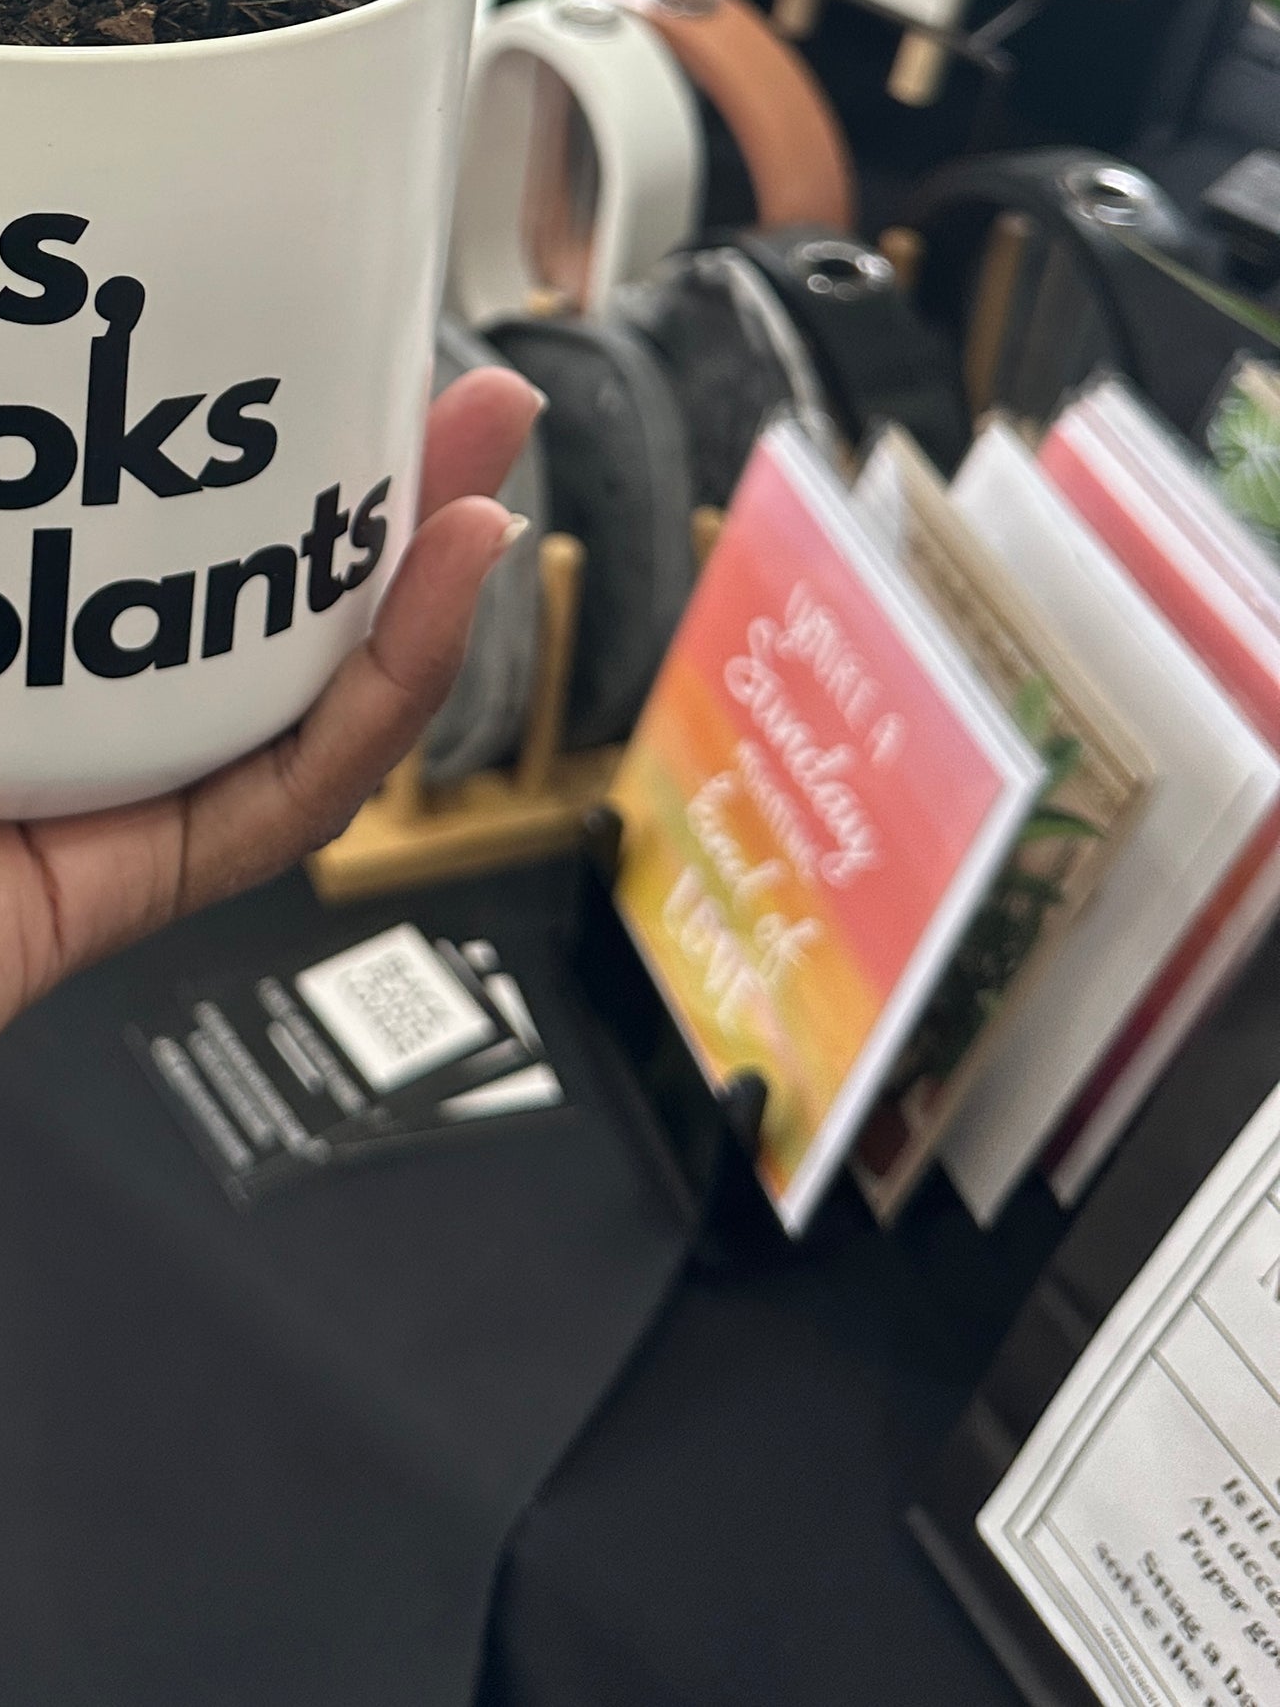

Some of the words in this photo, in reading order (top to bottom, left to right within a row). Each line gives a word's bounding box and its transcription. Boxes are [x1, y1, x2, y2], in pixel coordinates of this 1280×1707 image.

[1140, 1550, 1202, 1642] Snag
[1179, 1527, 1251, 1613] Paper
[1243, 1621, 1280, 1668] go
[1191, 1497, 1229, 1537] An
[1228, 1542, 1280, 1618] acce
[1161, 1631, 1204, 1691] the
